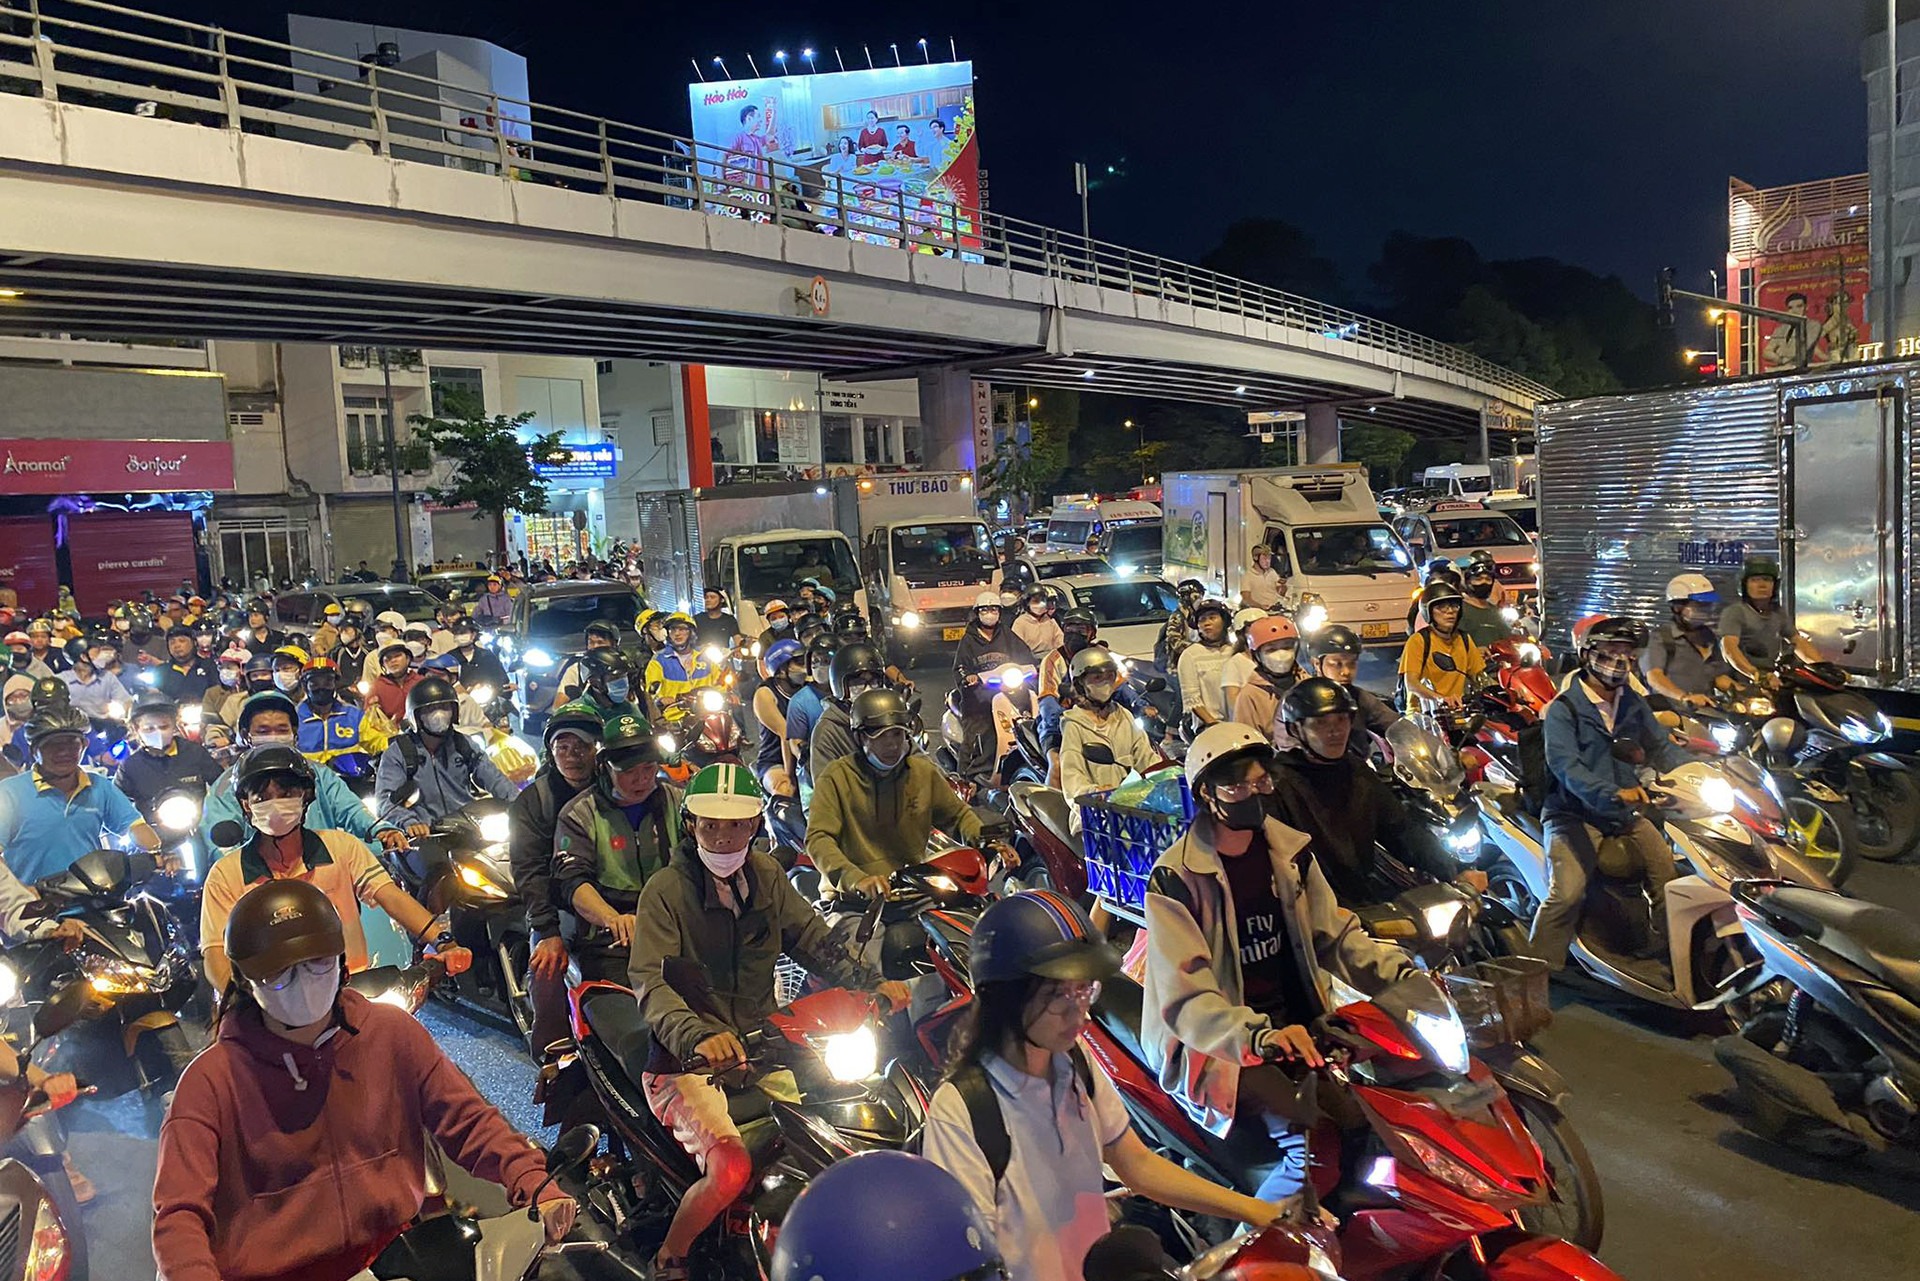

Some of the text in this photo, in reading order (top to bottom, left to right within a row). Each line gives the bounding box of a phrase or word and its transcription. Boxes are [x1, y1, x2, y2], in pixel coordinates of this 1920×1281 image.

[3, 450, 66, 475] Anamai
[126, 455, 180, 476] Bonjour
[922, 478, 948, 493] BÁO
[131, 558, 164, 568] cardin
[937, 580, 965, 588] ISUZU
[335, 722, 355, 738] be
[1246, 914, 1273, 935] Fly
